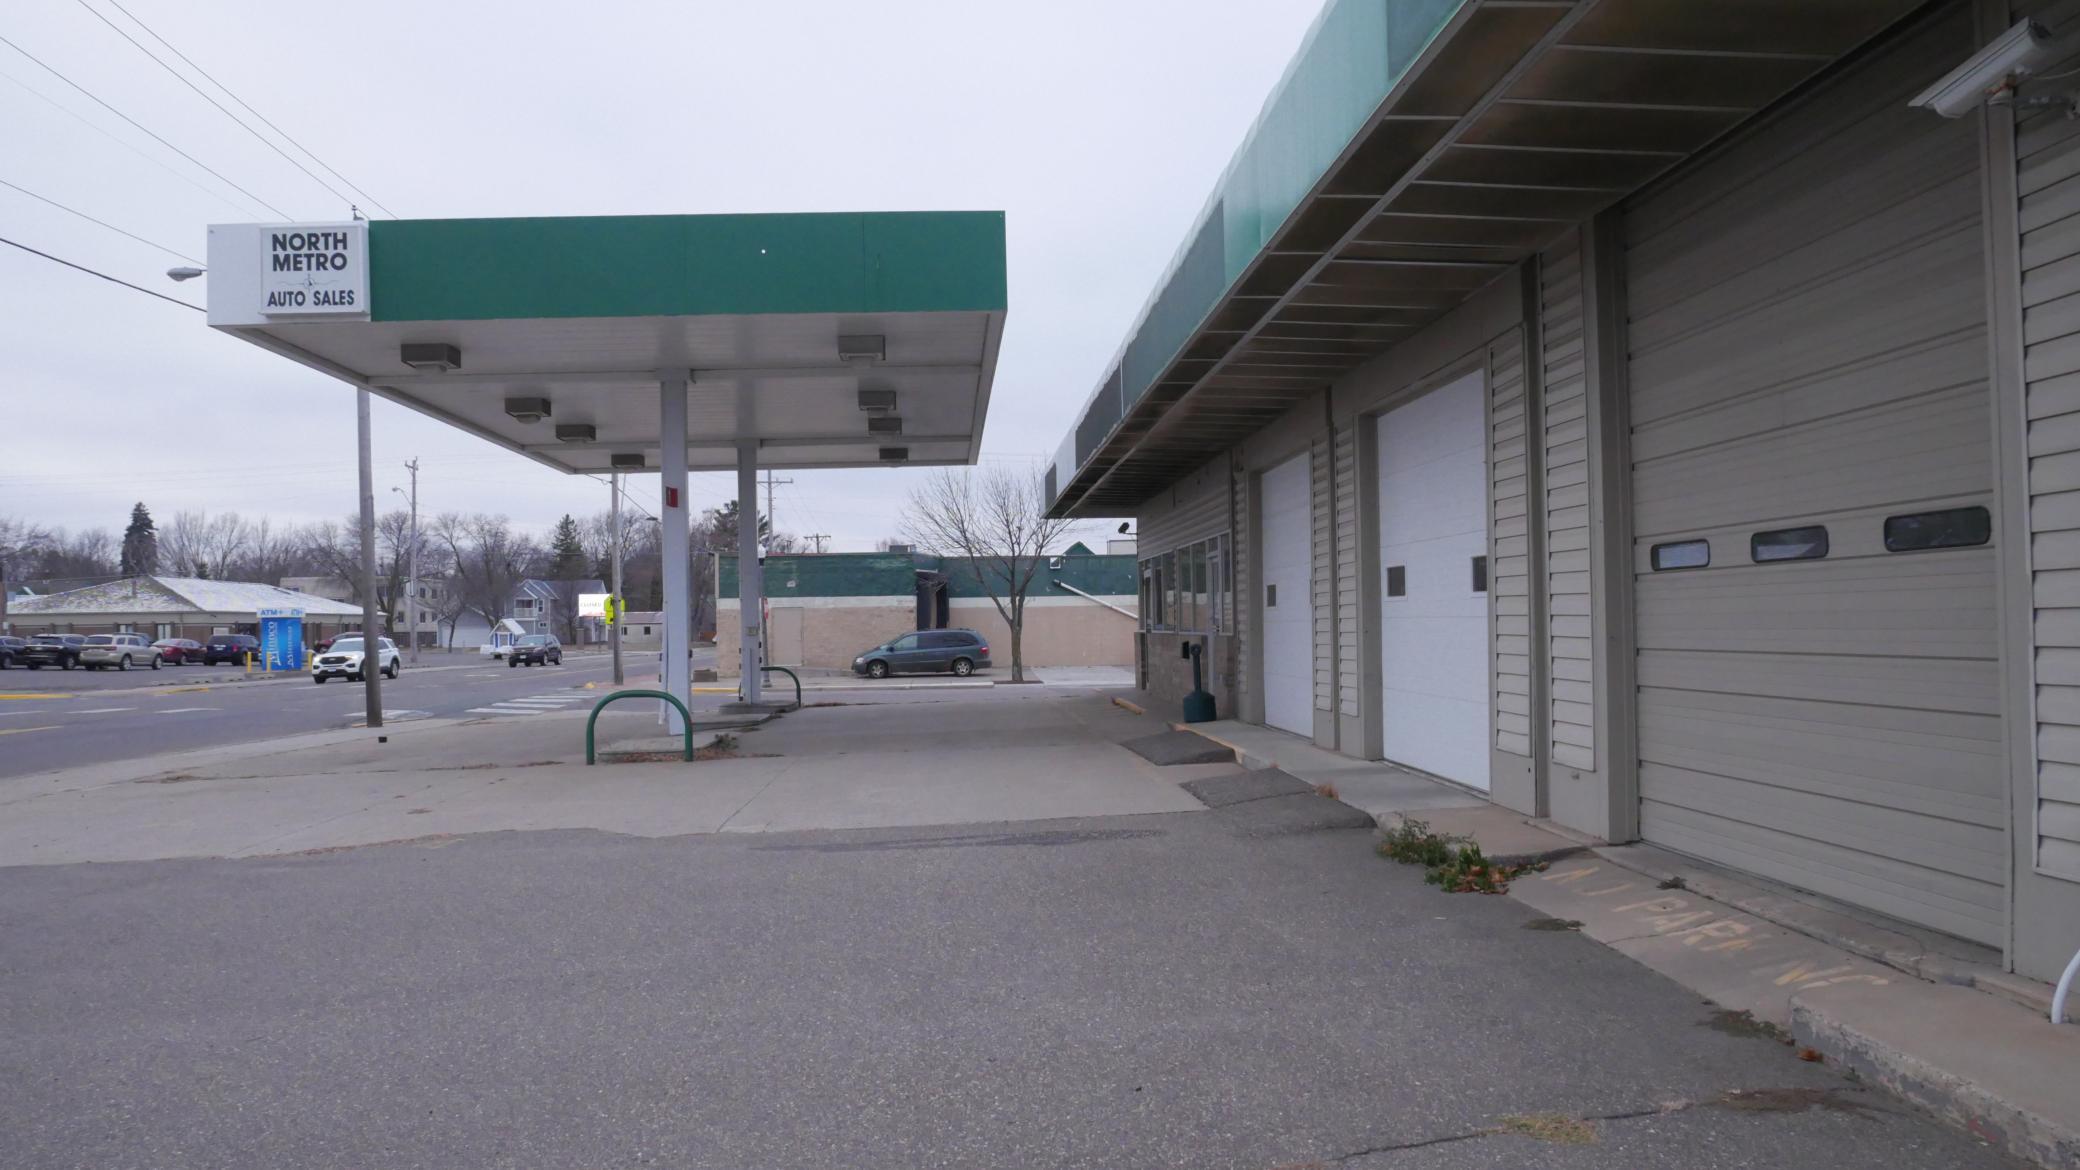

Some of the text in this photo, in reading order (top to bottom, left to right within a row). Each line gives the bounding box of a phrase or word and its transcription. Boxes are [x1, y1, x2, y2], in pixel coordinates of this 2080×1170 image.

[272, 232, 348, 251] NORTH
[272, 252, 348, 272] METRO
[267, 290, 355, 307] AUTO SALES
